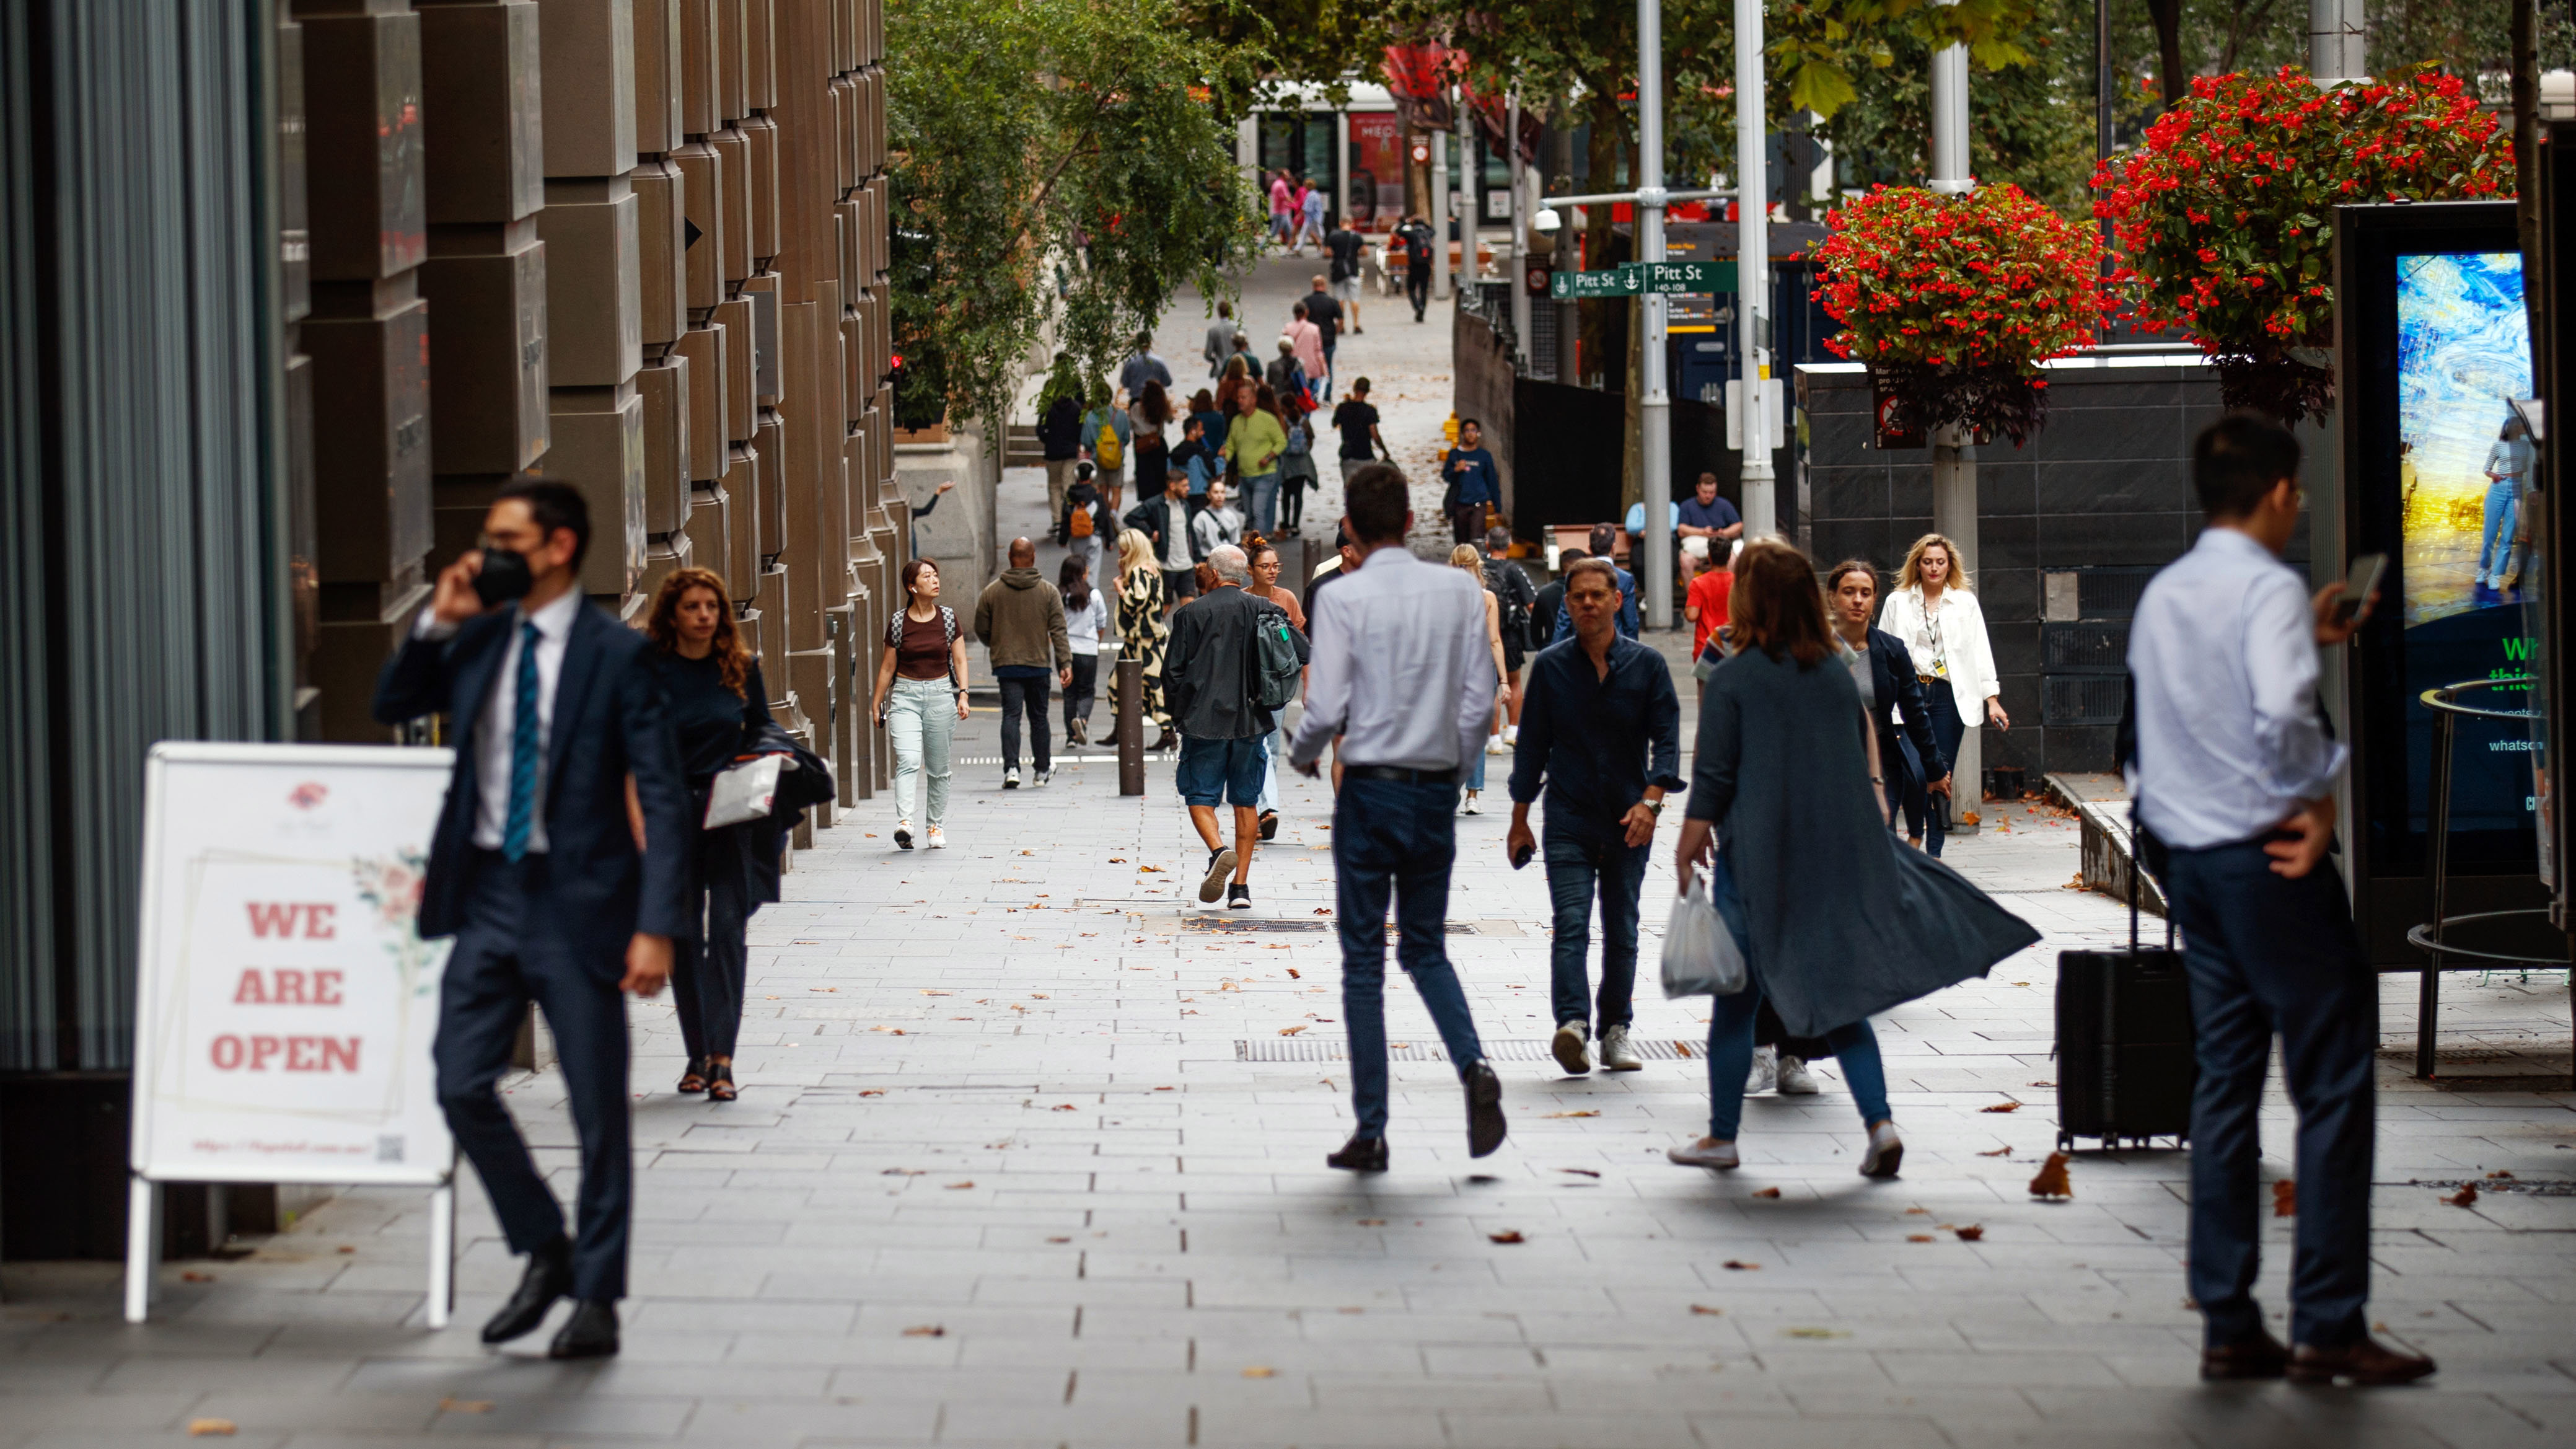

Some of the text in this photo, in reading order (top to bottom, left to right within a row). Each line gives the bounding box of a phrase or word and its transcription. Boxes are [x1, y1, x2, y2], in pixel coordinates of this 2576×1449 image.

[1576, 273, 1615, 288] Pitt St
[1655, 265, 1702, 280] Pitt St
[1655, 283, 1686, 292] 140-108
[246, 902, 335, 940] WE
[234, 969, 343, 1006] ARE
[210, 1034, 361, 1073] OPEN
